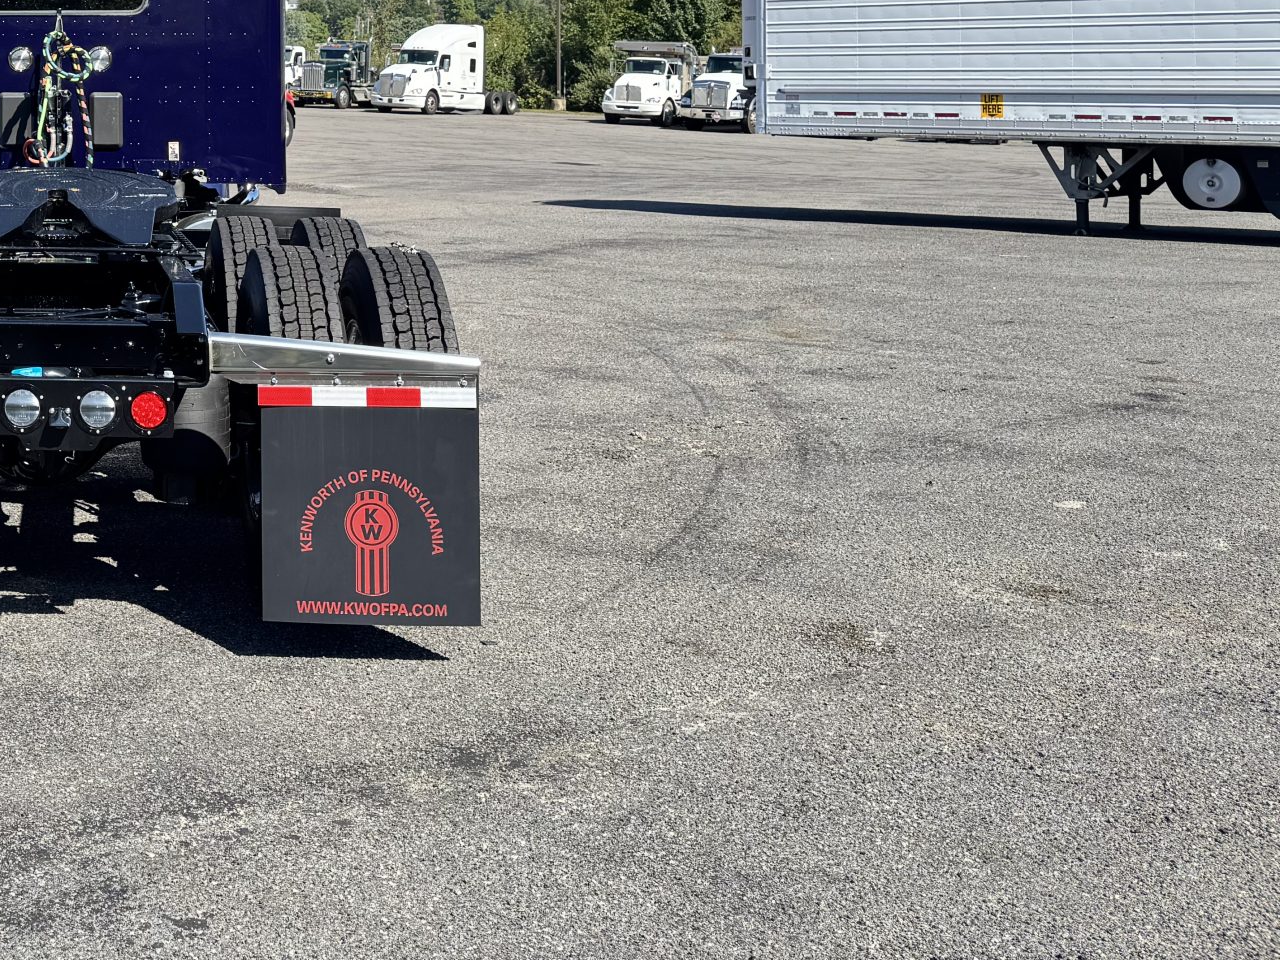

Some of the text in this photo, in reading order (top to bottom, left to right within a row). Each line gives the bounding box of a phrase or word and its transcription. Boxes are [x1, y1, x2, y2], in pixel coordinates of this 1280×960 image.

[984, 94, 1000, 103] LIFT
[982, 104, 1002, 114] HERE
[300, 469, 444, 555] KENWORTH OF PENNSYLVANIA
[364, 508, 379, 524] K
[360, 524, 383, 540] W
[296, 600, 448, 617] WWW.KWOFPA.COM
